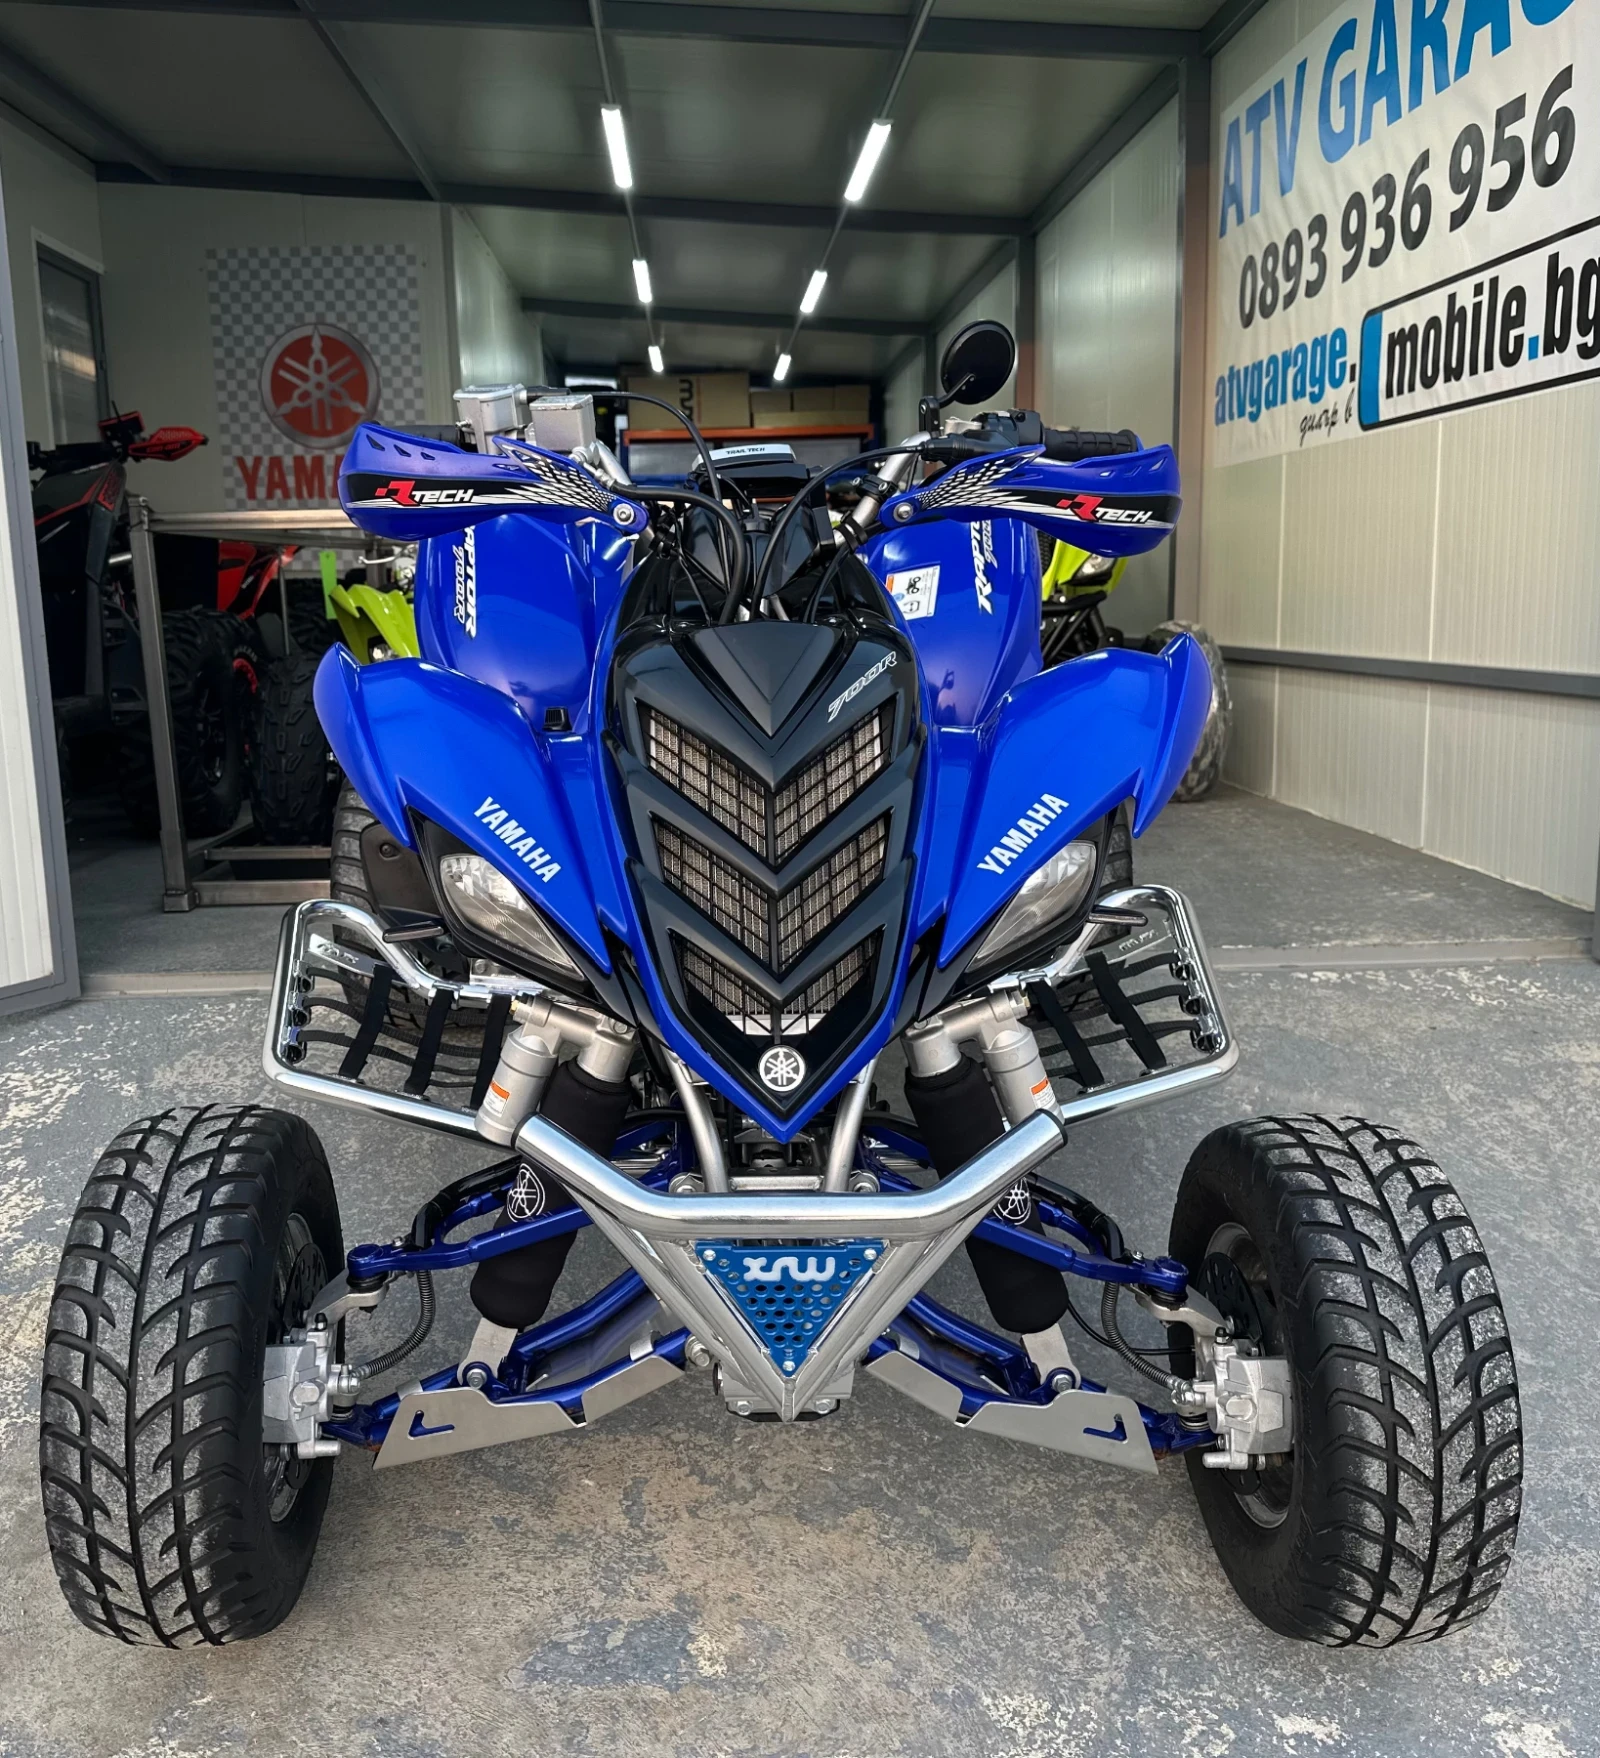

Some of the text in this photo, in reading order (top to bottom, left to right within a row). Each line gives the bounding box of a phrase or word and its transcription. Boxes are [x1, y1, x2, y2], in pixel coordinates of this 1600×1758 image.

[1219, 58, 1308, 239] ATV
[1239, 64, 1576, 329] 0893 936 956
[1385, 251, 1600, 400] mobile.bg
[464, 525, 477, 638] APTOR
[827, 651, 898, 724] 700R
[473, 796, 562, 883] YAMAHA
[977, 793, 1070, 875] YAMAHA
